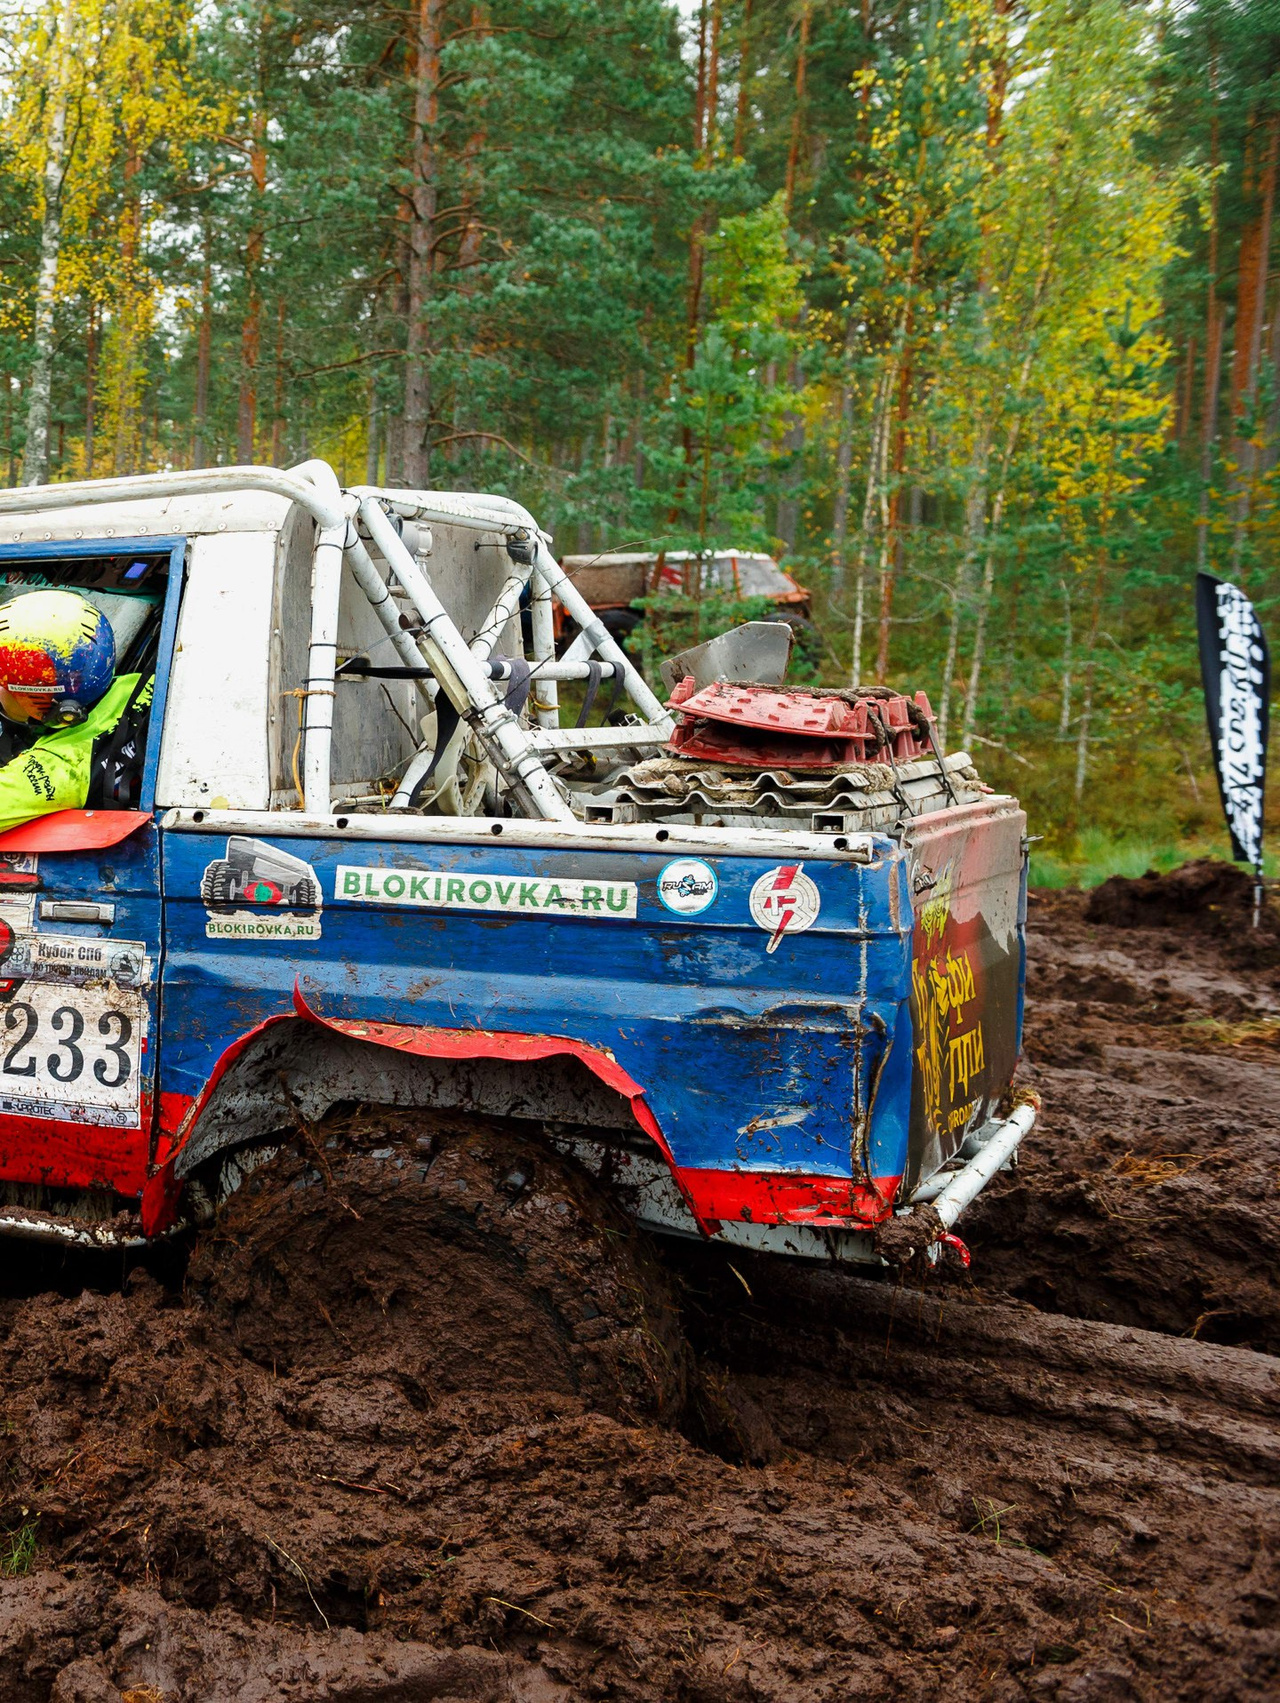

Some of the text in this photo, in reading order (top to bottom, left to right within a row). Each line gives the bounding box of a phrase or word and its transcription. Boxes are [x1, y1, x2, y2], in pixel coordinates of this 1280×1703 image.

[343, 871, 628, 912] BLOKIROVKA.RU
[38, 942, 102, 962] Кубок СПб
[3, 1002, 132, 1088] 233
